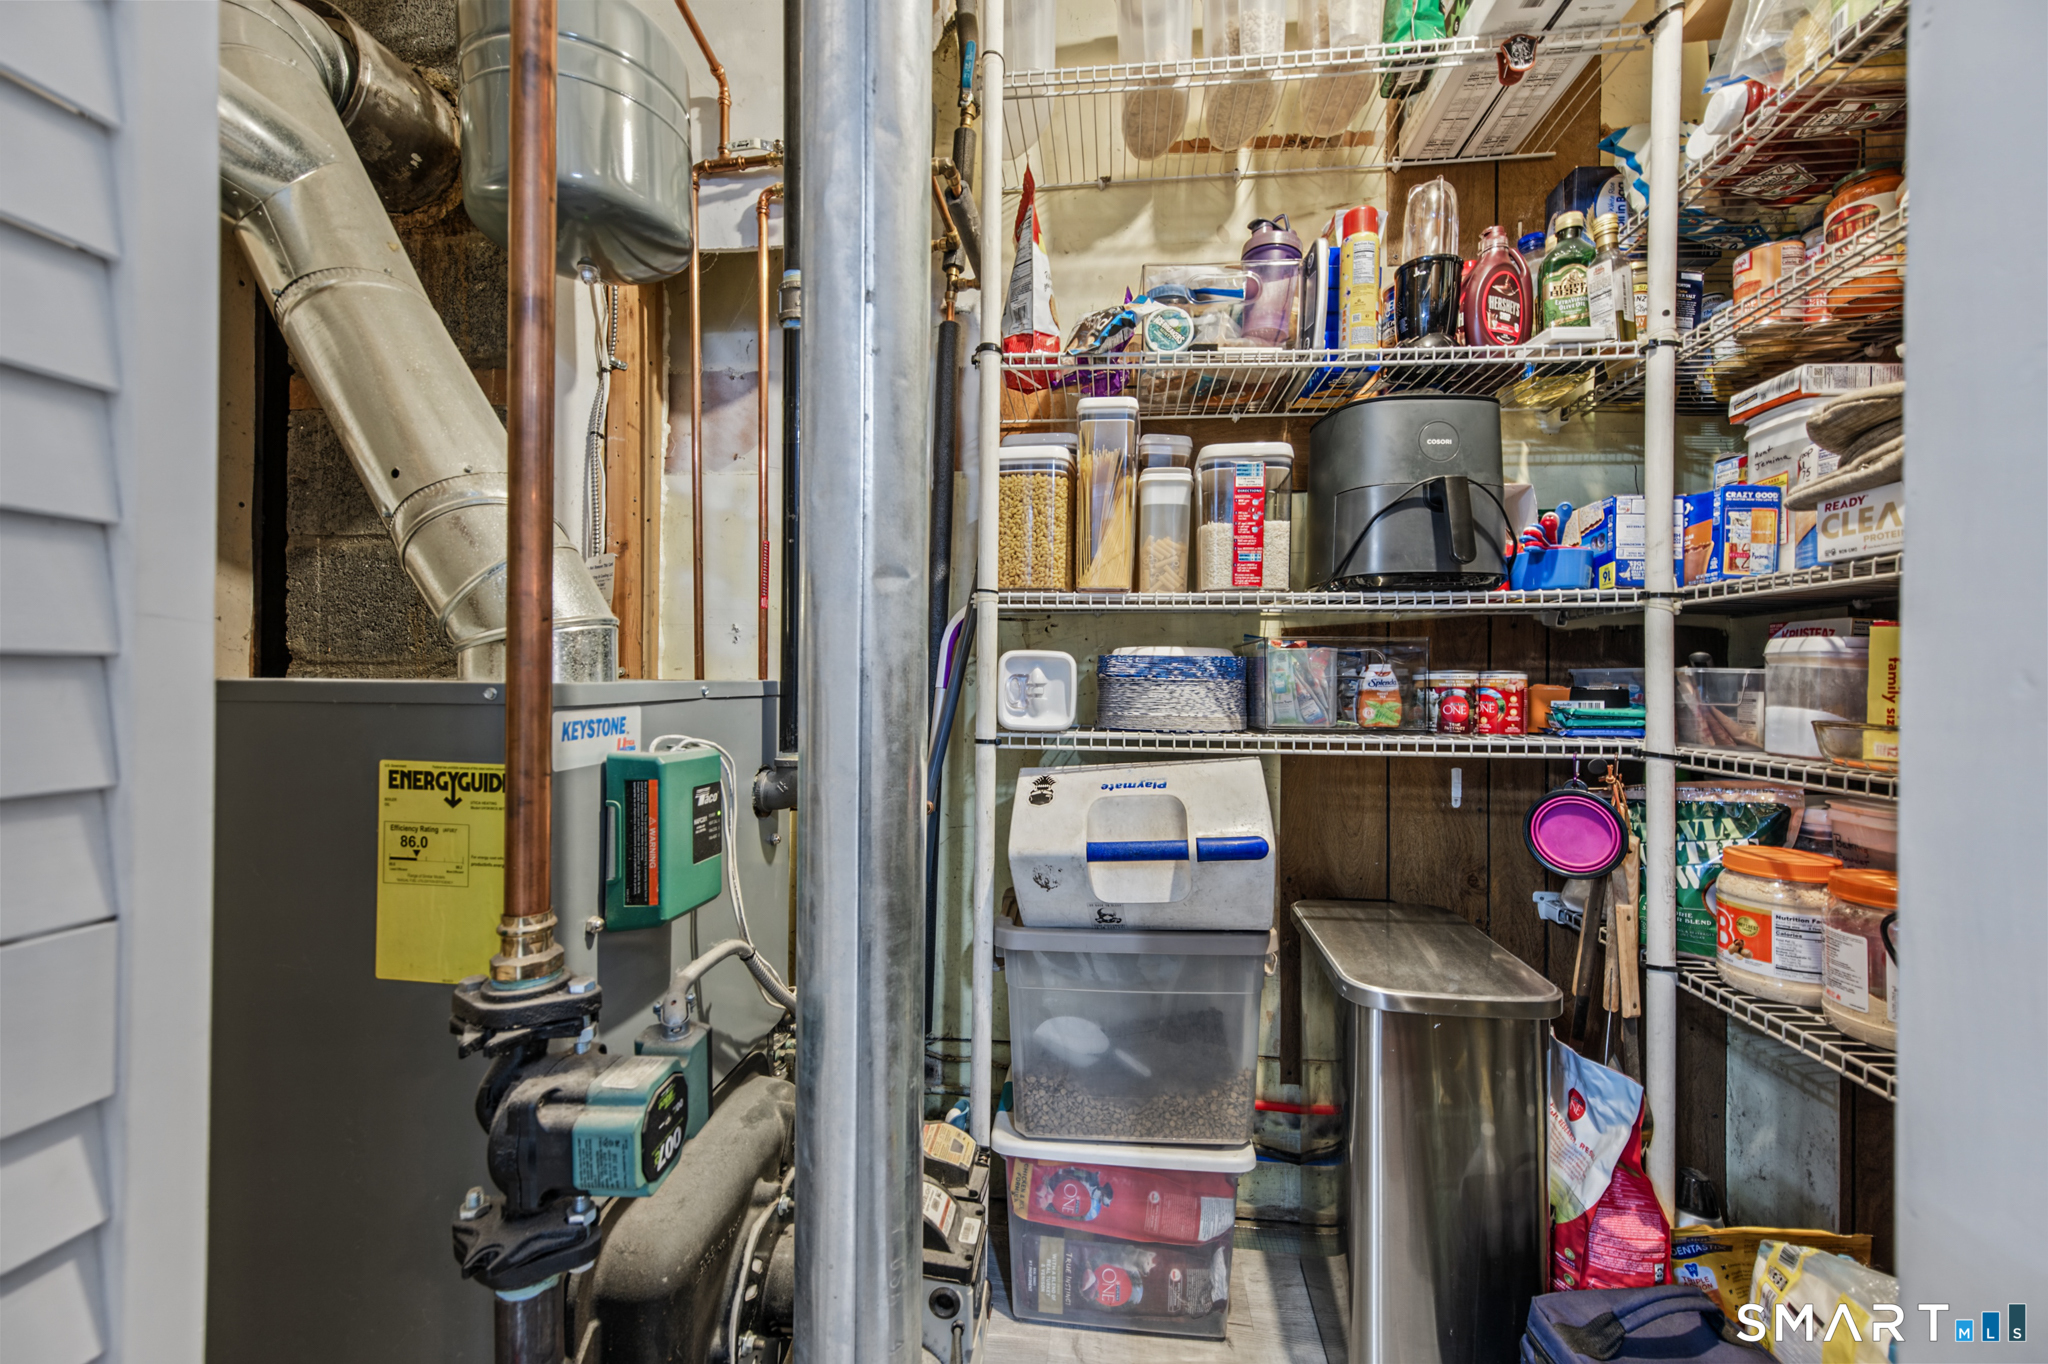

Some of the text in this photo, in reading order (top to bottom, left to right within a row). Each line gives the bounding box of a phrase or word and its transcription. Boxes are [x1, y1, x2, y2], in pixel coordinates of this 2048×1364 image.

[1616, 203, 1625, 214] in
[1488, 295, 1520, 317] HERSHEY'S
[1754, 446, 1773, 459] Aunt
[1725, 491, 1779, 499] CRAZY GOOD
[1825, 494, 1866, 512] READY
[1442, 704, 1467, 715] ONE
[1886, 708, 1899, 726] siz
[561, 716, 627, 742] KEYSTONE
[1101, 781, 1168, 792] Playmate
[390, 823, 439, 834] Efficiency Rating
[400, 834, 429, 849] 86.0
[649, 827, 657, 869] WARNING
[1775, 914, 1810, 924] Nutrition
[1775, 930, 1803, 939] Calories
[1020, 1163, 1030, 1194] CHICKEN
[1061, 1183, 1078, 1215] ONE
[1064, 1252, 1073, 1307] TRUE INSTINCT
[1101, 1267, 1117, 1304] ONE
[1682, 1276, 1710, 1284] TRIPLE
